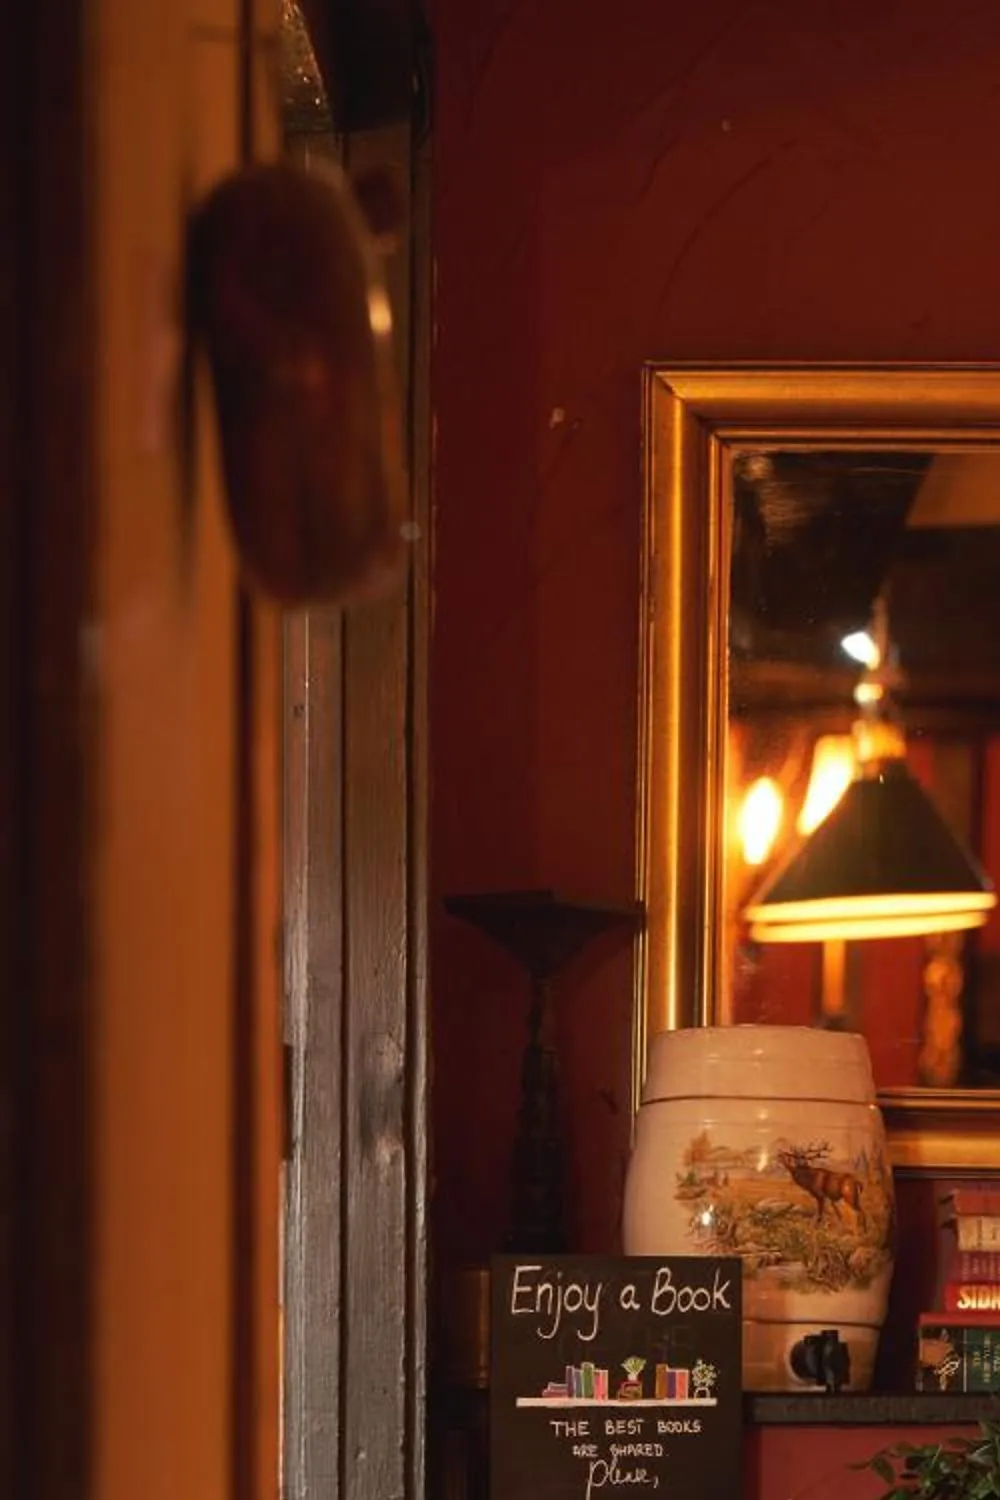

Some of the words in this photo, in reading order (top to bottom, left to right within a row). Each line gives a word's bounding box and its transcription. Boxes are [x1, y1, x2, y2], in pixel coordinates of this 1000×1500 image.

[511, 1265, 603, 1341] Enjoy
[619, 1284, 641, 1311] a
[651, 1266, 731, 1316] Book
[549, 1420, 591, 1437] THE
[604, 1419, 645, 1435] BEST
[657, 1419, 702, 1434] BOOKS
[572, 1443, 598, 1458] ARE
